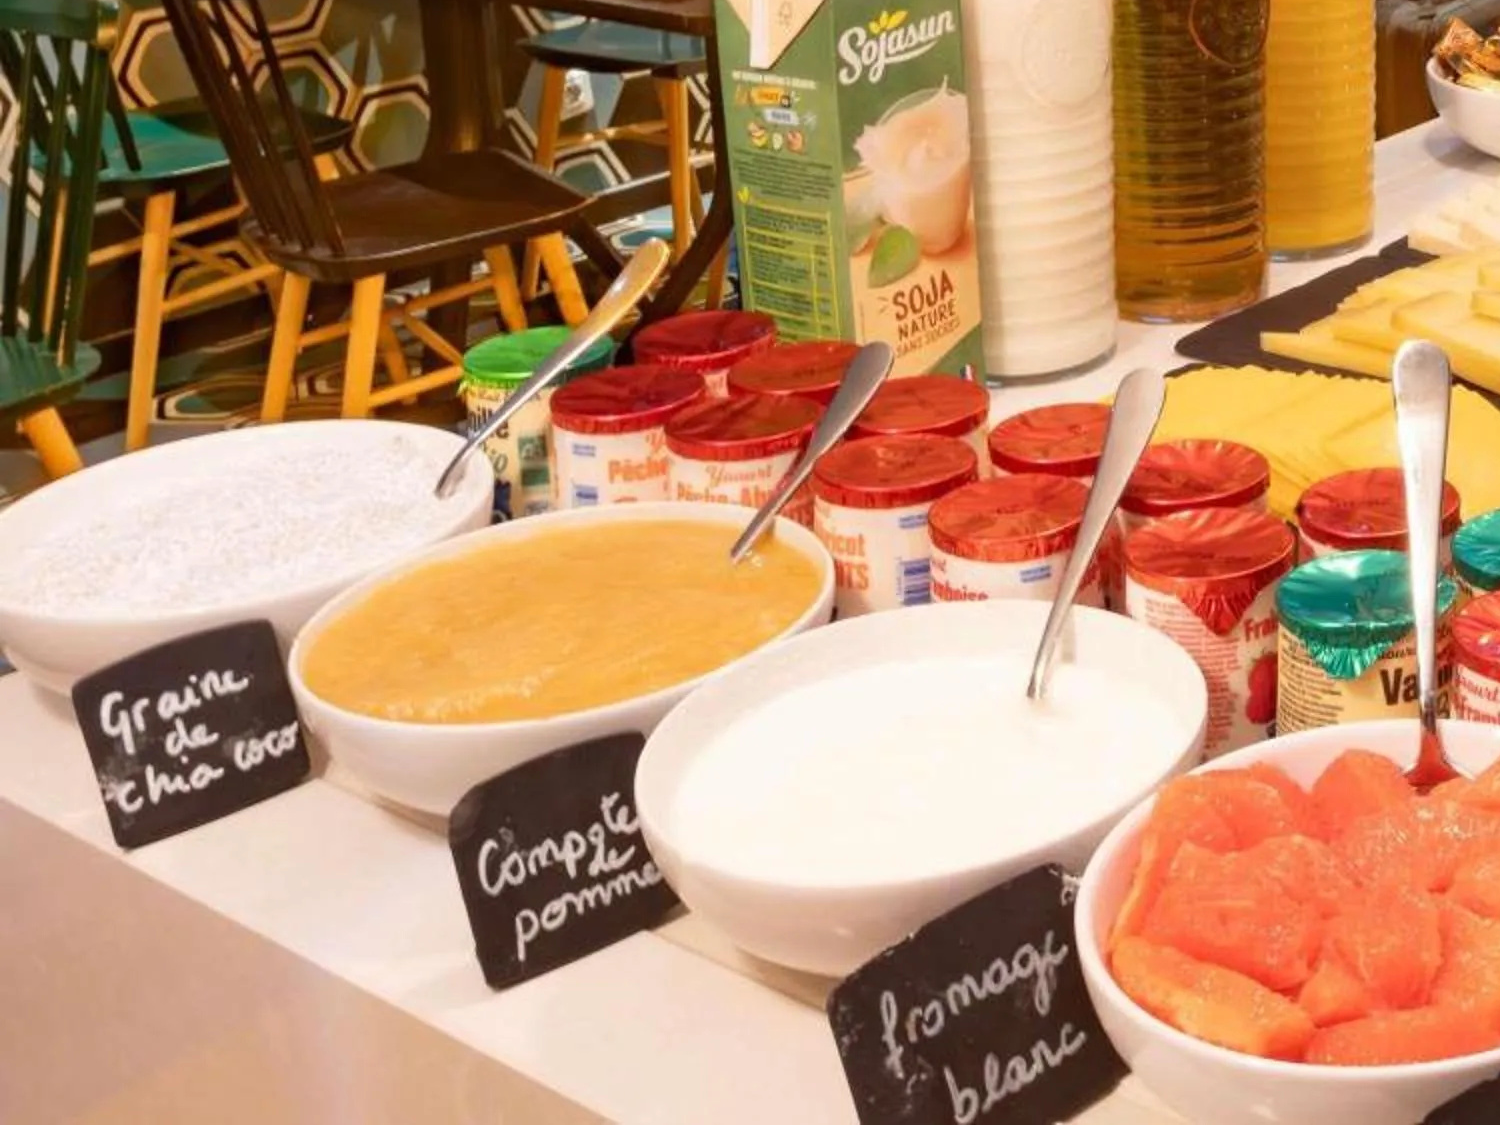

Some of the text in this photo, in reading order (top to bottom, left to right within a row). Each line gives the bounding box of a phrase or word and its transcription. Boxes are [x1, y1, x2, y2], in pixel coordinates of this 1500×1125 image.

[838, 10, 956, 85] Sojasun
[892, 268, 954, 322] SOJA
[897, 298, 957, 342] NATURE
[101, 670, 249, 755] Graine
[165, 717, 219, 755] de
[117, 721, 298, 813] chia coco
[515, 863, 662, 962] pomme
[880, 930, 1068, 1080] fromage
[944, 1023, 1087, 1124] blanc
